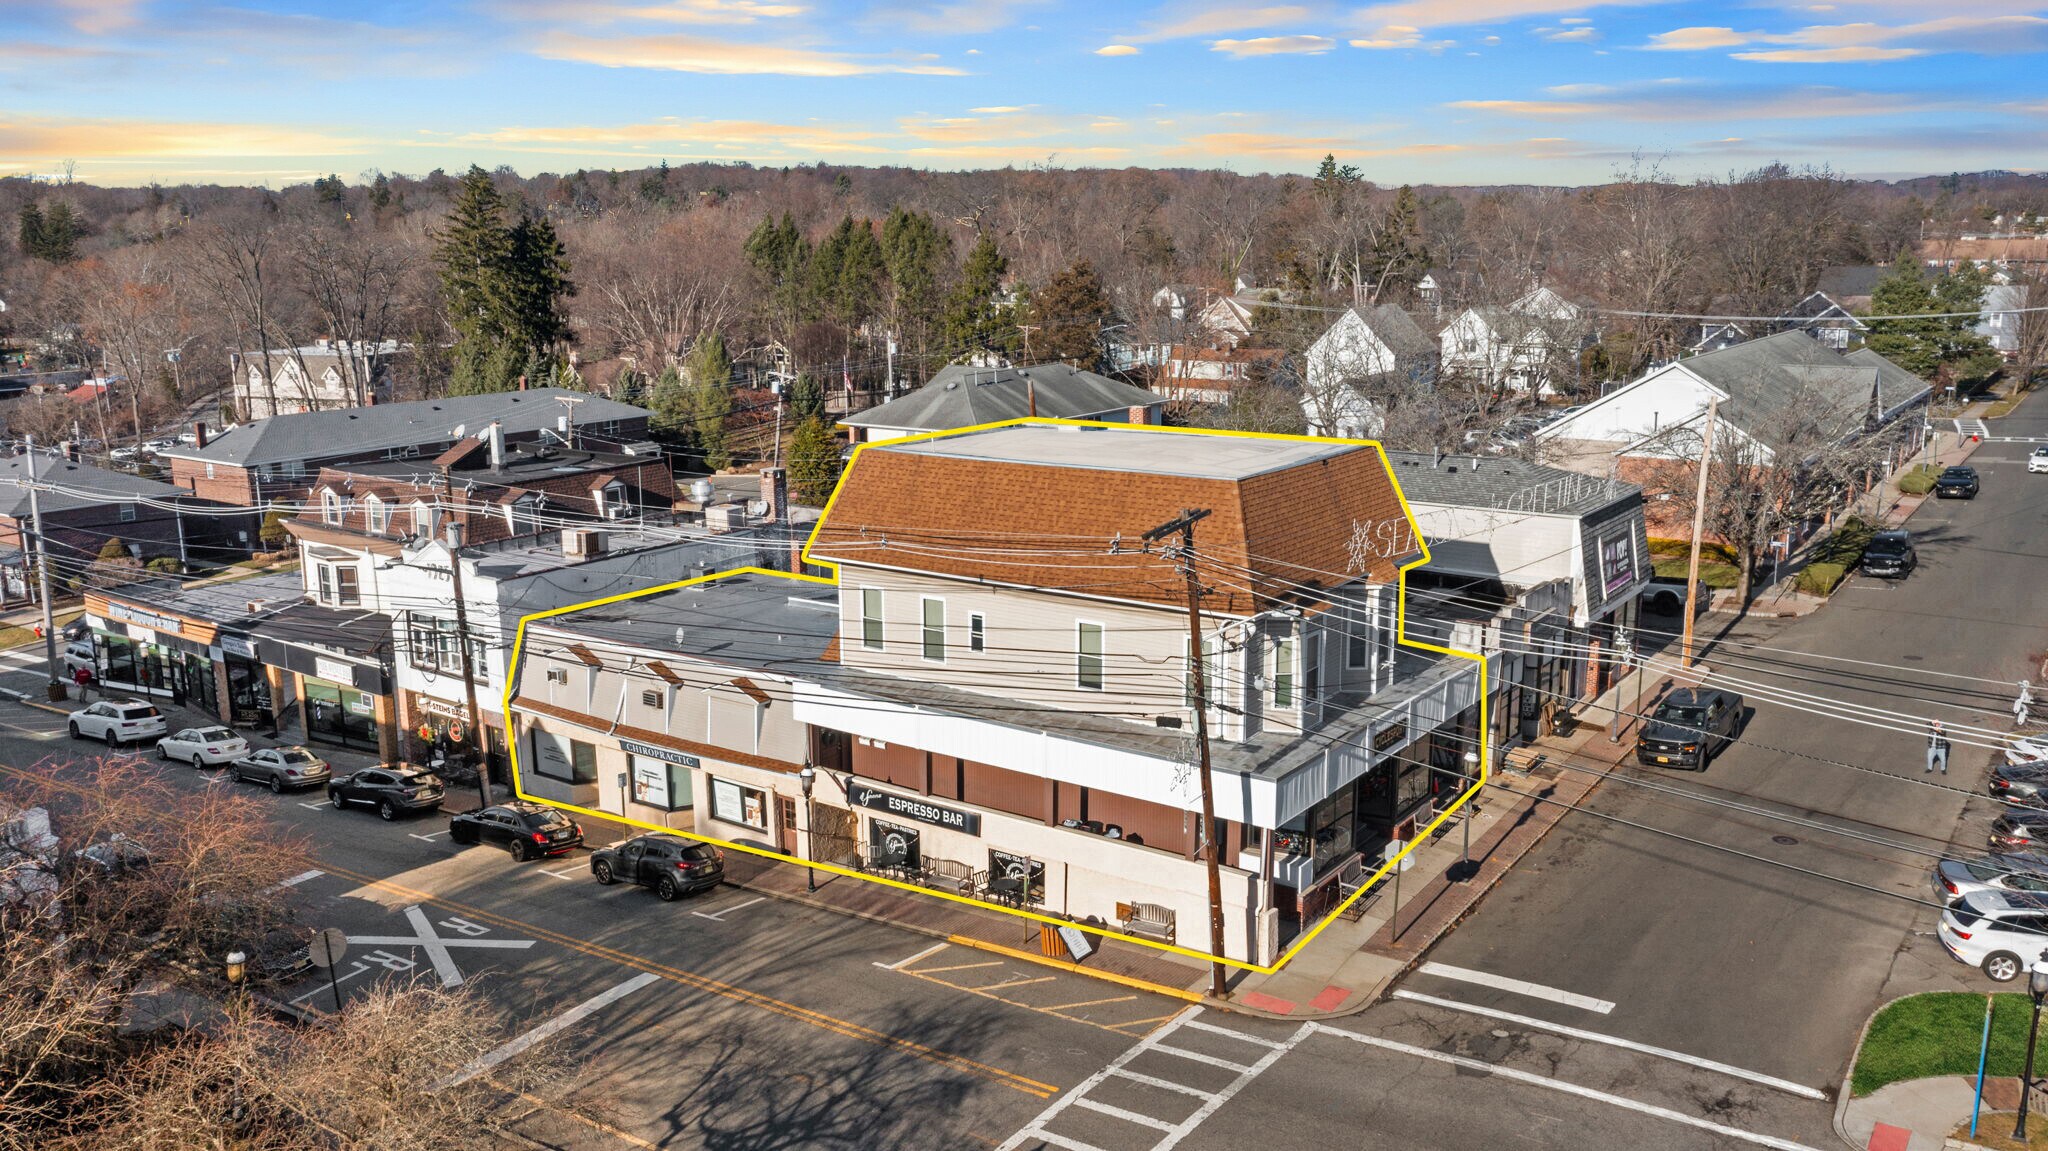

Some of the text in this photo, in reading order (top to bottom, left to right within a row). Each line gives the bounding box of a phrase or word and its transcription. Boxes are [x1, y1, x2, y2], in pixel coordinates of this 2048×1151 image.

[452, 708, 470, 720] BAGEL
[626, 743, 693, 766] CHIROPRACTIC
[888, 797, 940, 820] ESPRESSO
[942, 811, 963, 827] BAR
